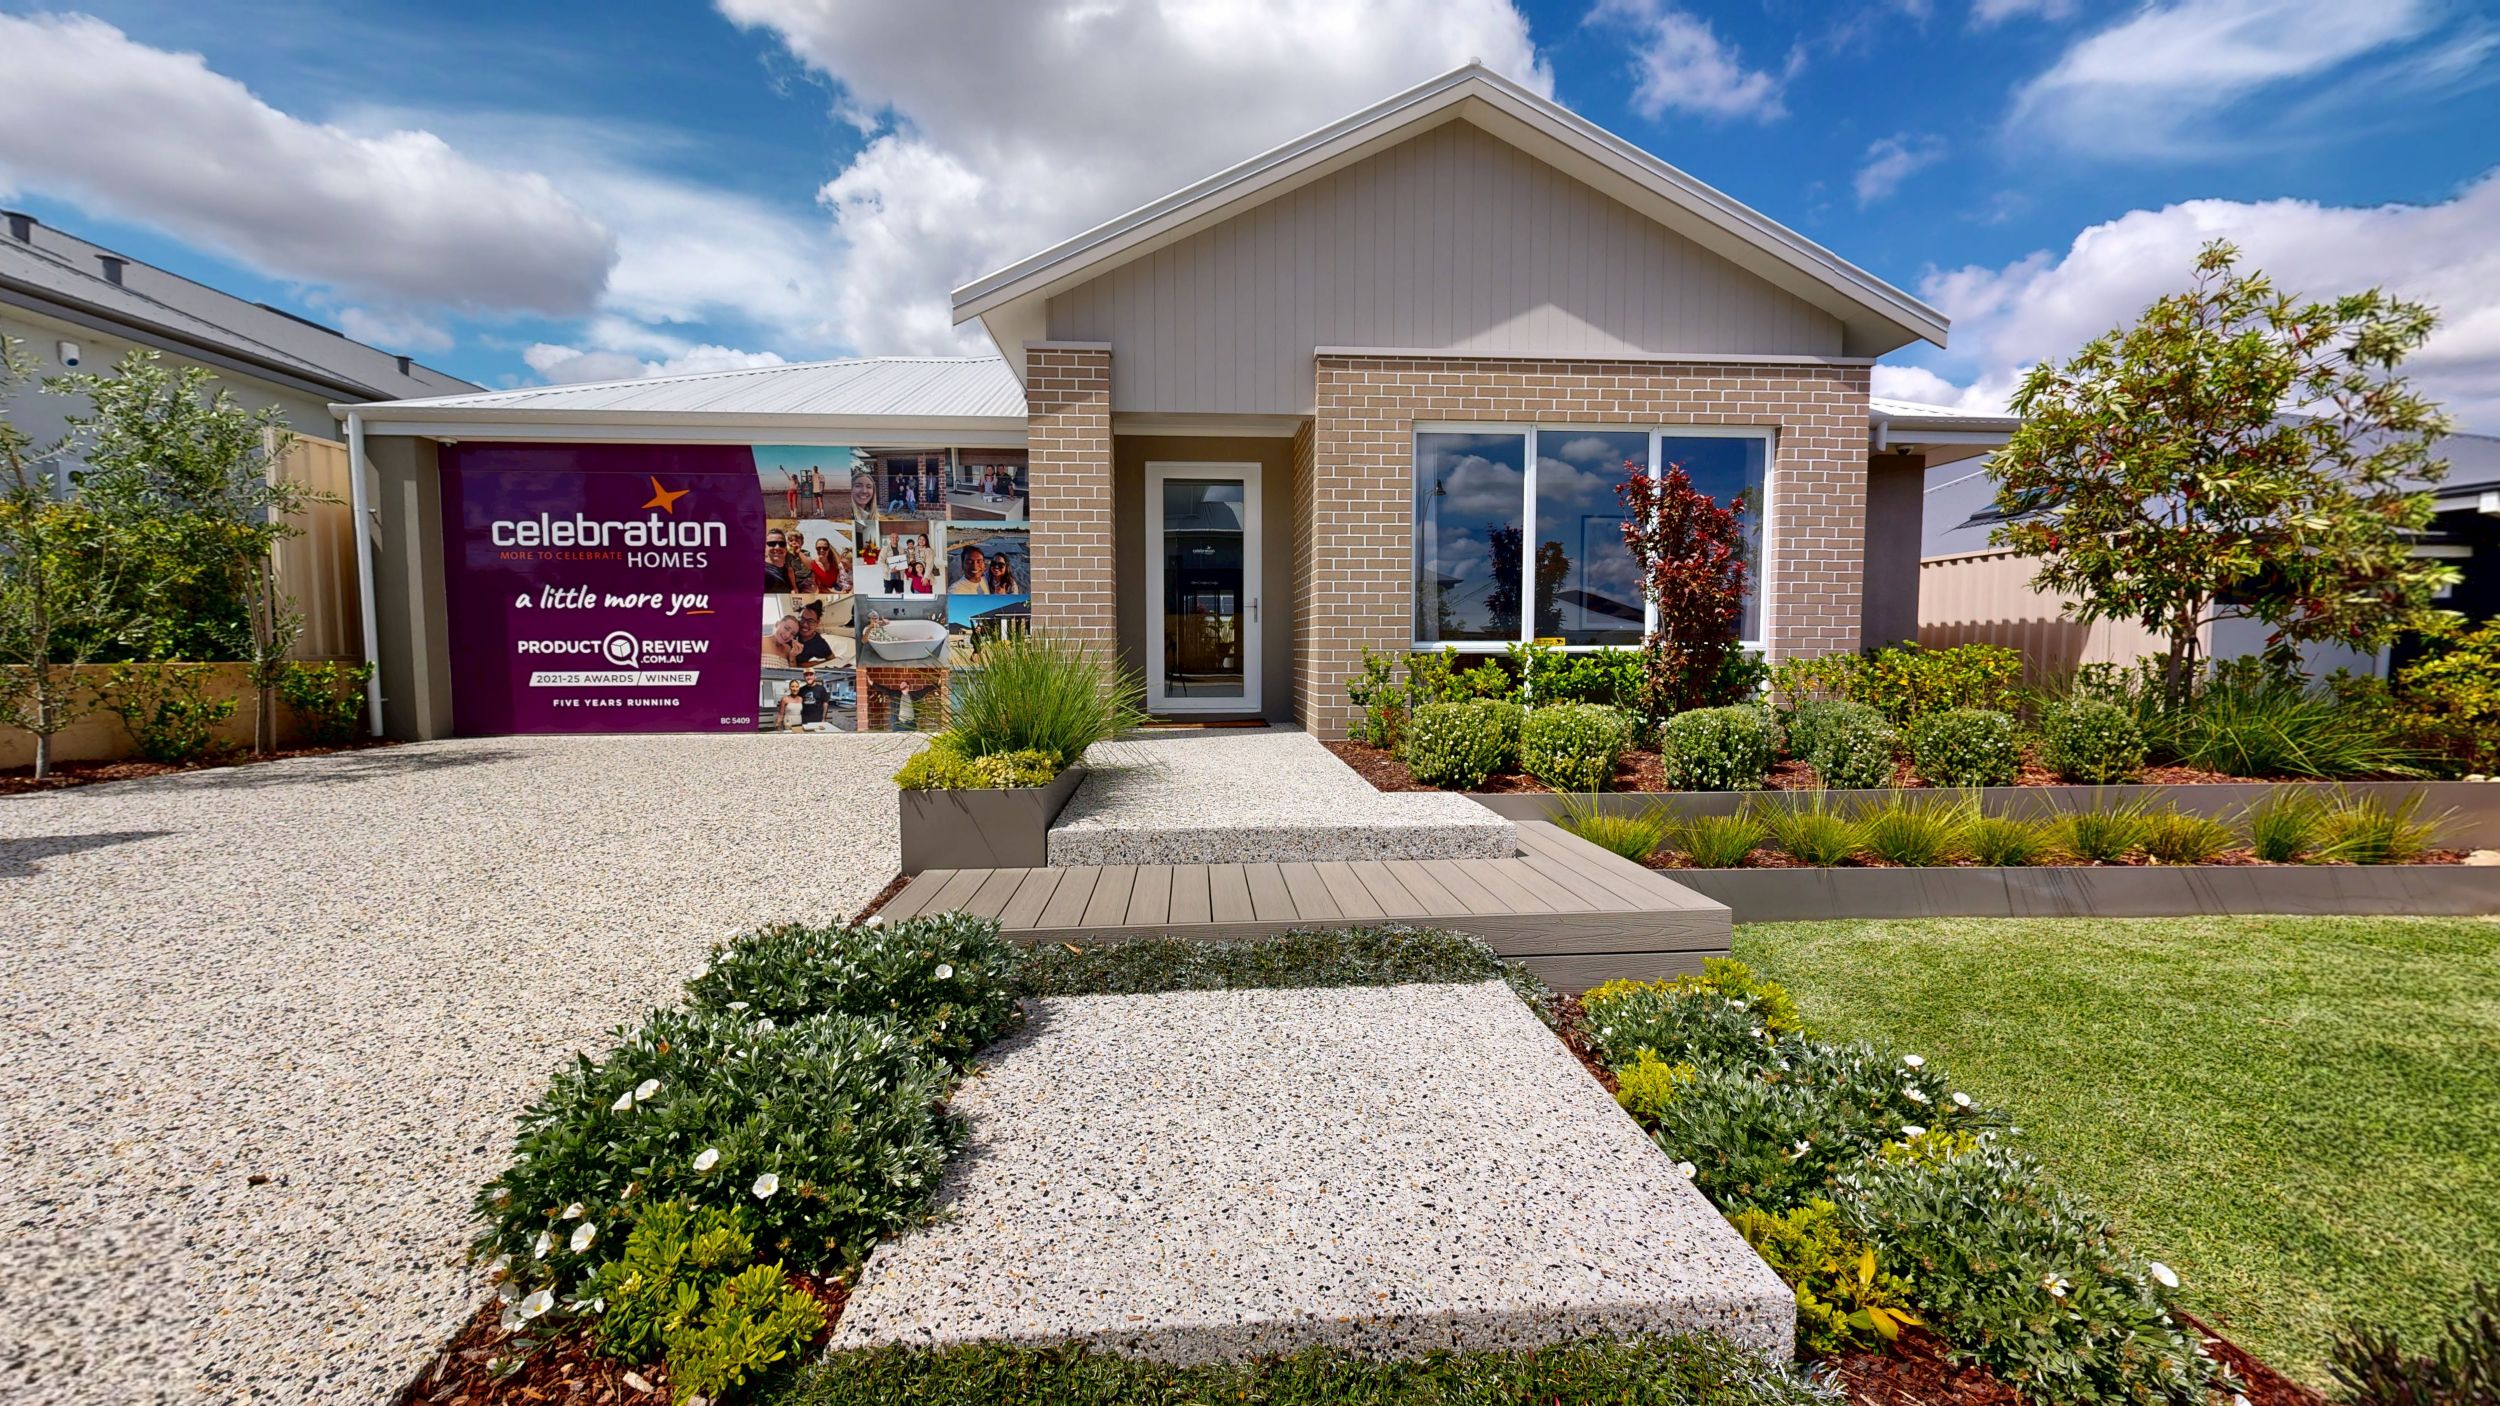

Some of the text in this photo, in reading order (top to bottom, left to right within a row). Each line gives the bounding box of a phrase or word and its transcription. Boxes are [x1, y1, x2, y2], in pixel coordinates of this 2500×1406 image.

[491, 512, 727, 547] celebration
[501, 552, 623, 560] MORE TO CELEBRATE
[628, 552, 708, 568] HOMES
[515, 585, 709, 616] a little more you
[518, 640, 709, 653] PRODUCT REVIEW
[640, 655, 684, 664] .COM.AU
[536, 674, 692, 683] 2021-25 AWARDS WINNER
[553, 699, 680, 707] FIVE YEARS RUNNING
